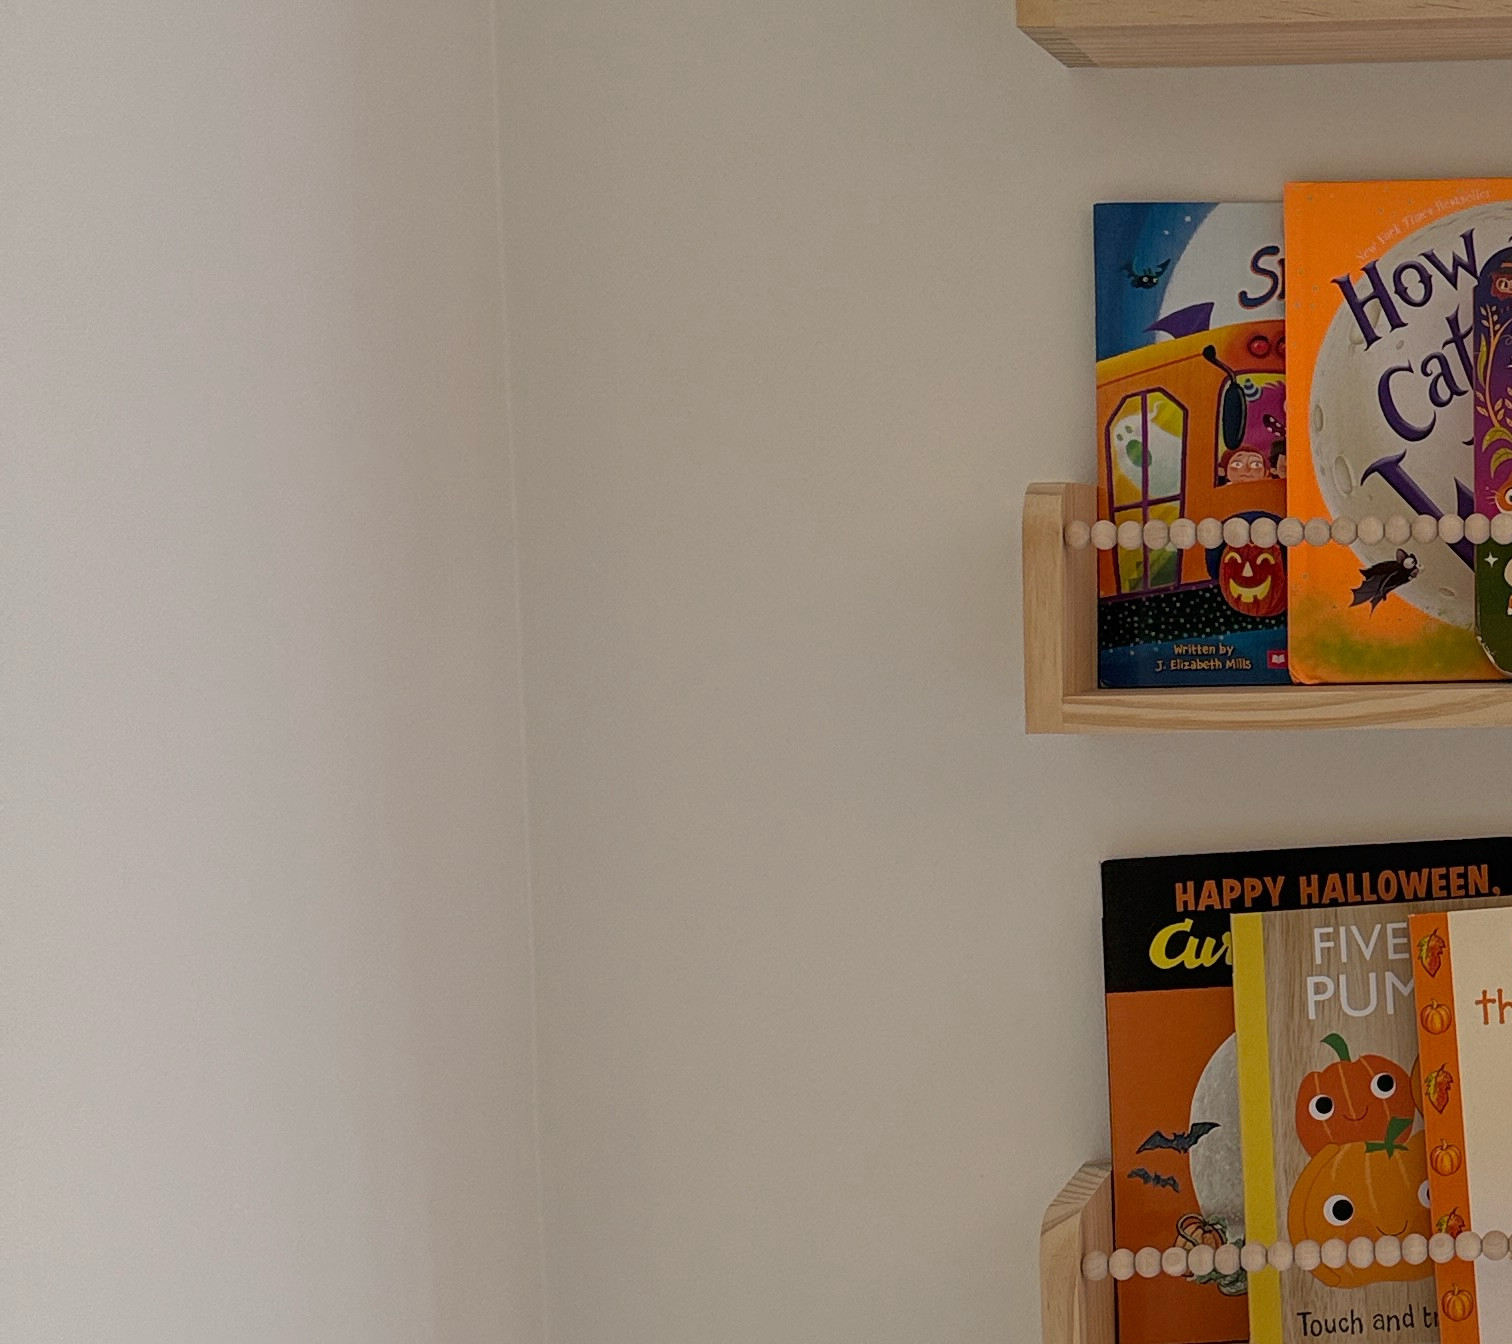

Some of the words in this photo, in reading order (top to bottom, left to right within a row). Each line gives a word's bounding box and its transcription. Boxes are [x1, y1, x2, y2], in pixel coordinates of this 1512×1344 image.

[1238, 244, 1285, 311] S
[1332, 227, 1479, 351] How
[1154, 659, 1166, 672] J.
[1170, 658, 1223, 671] Elizabeth
[1225, 657, 1252, 670] Mills
[1173, 643, 1217, 656] Written
[1219, 642, 1234, 657] by
[1175, 875, 1285, 912] HAPPY
[1299, 864, 1501, 906] HALLOWEEN,
[1312, 921, 1411, 966] FIVE
[1297, 1309, 1363, 1337] Touch
[1372, 1304, 1414, 1332] and
